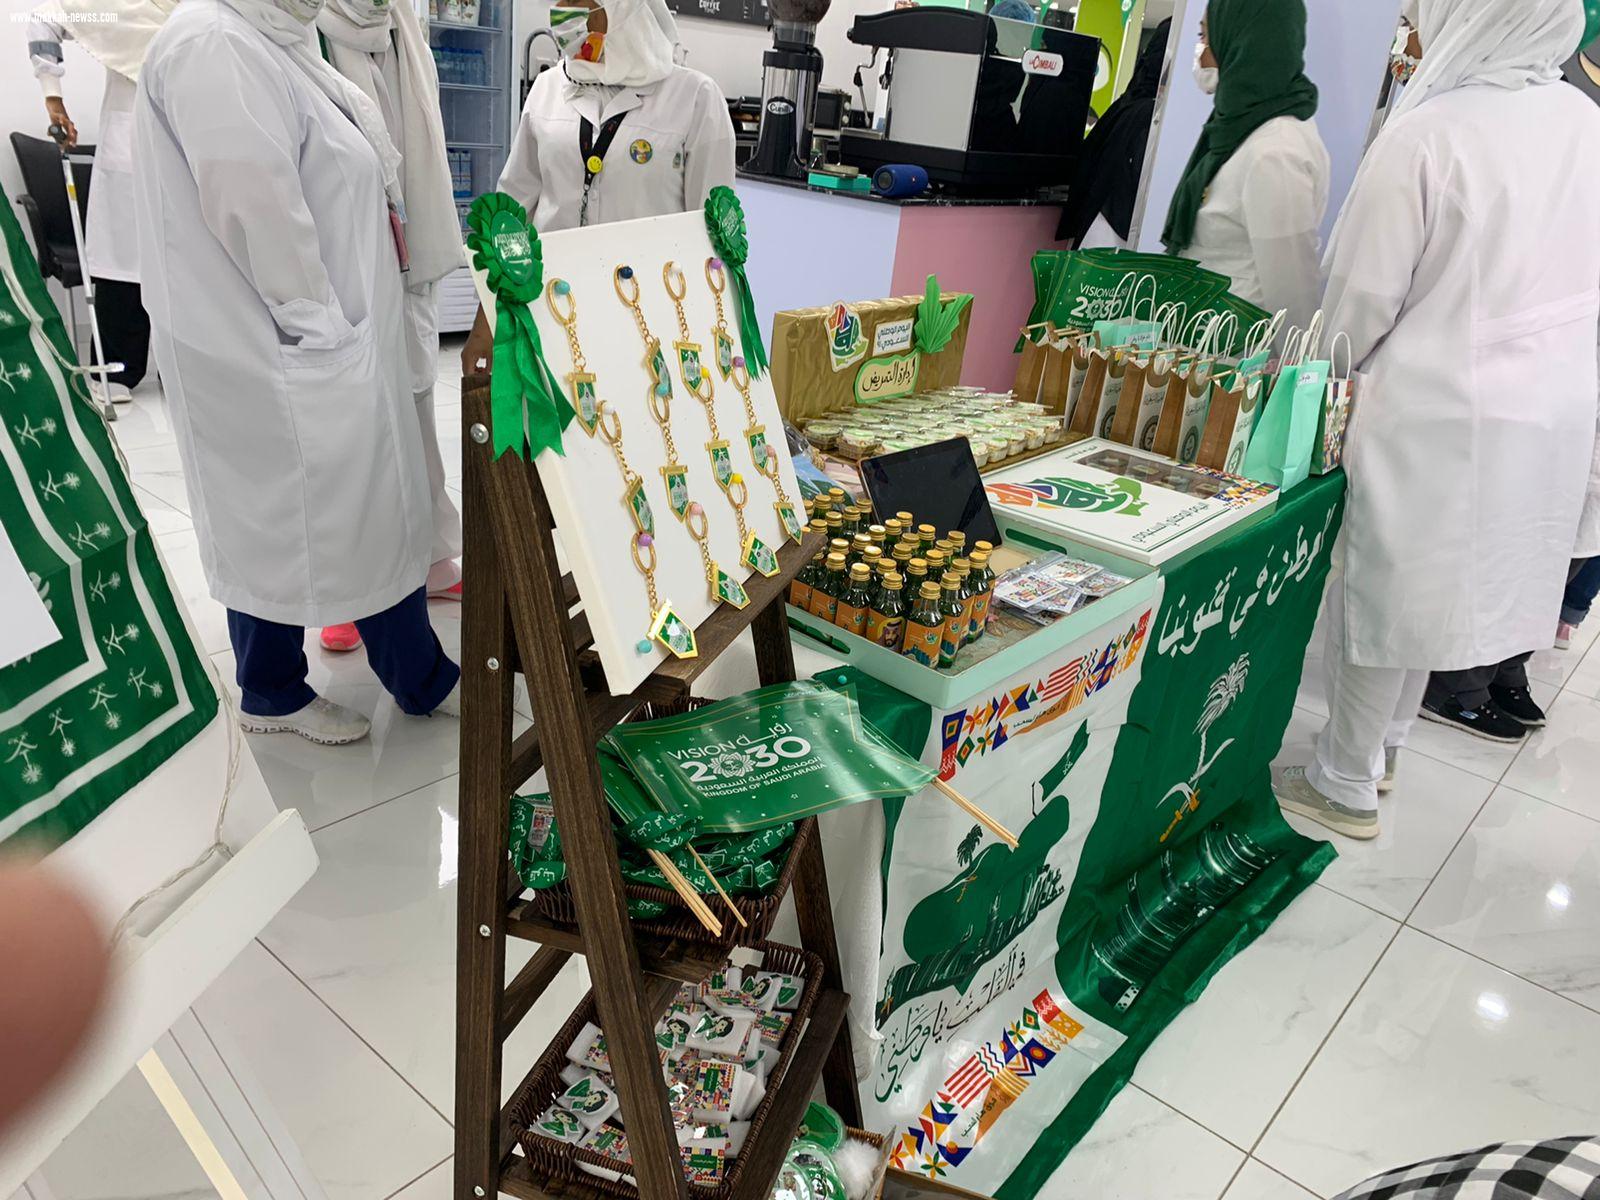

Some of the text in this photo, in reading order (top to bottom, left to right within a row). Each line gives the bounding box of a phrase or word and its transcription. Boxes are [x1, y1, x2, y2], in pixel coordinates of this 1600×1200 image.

[1080, 282, 1108, 297] VISION
[1158, 566, 1239, 658] قلوبنا
[667, 741, 736, 760] VISION
[679, 735, 812, 783] 2030
[696, 756, 822, 792] المملكة العربية السعودية
[702, 763, 827, 798] KINGDOM OF SAUDI ARABIA
